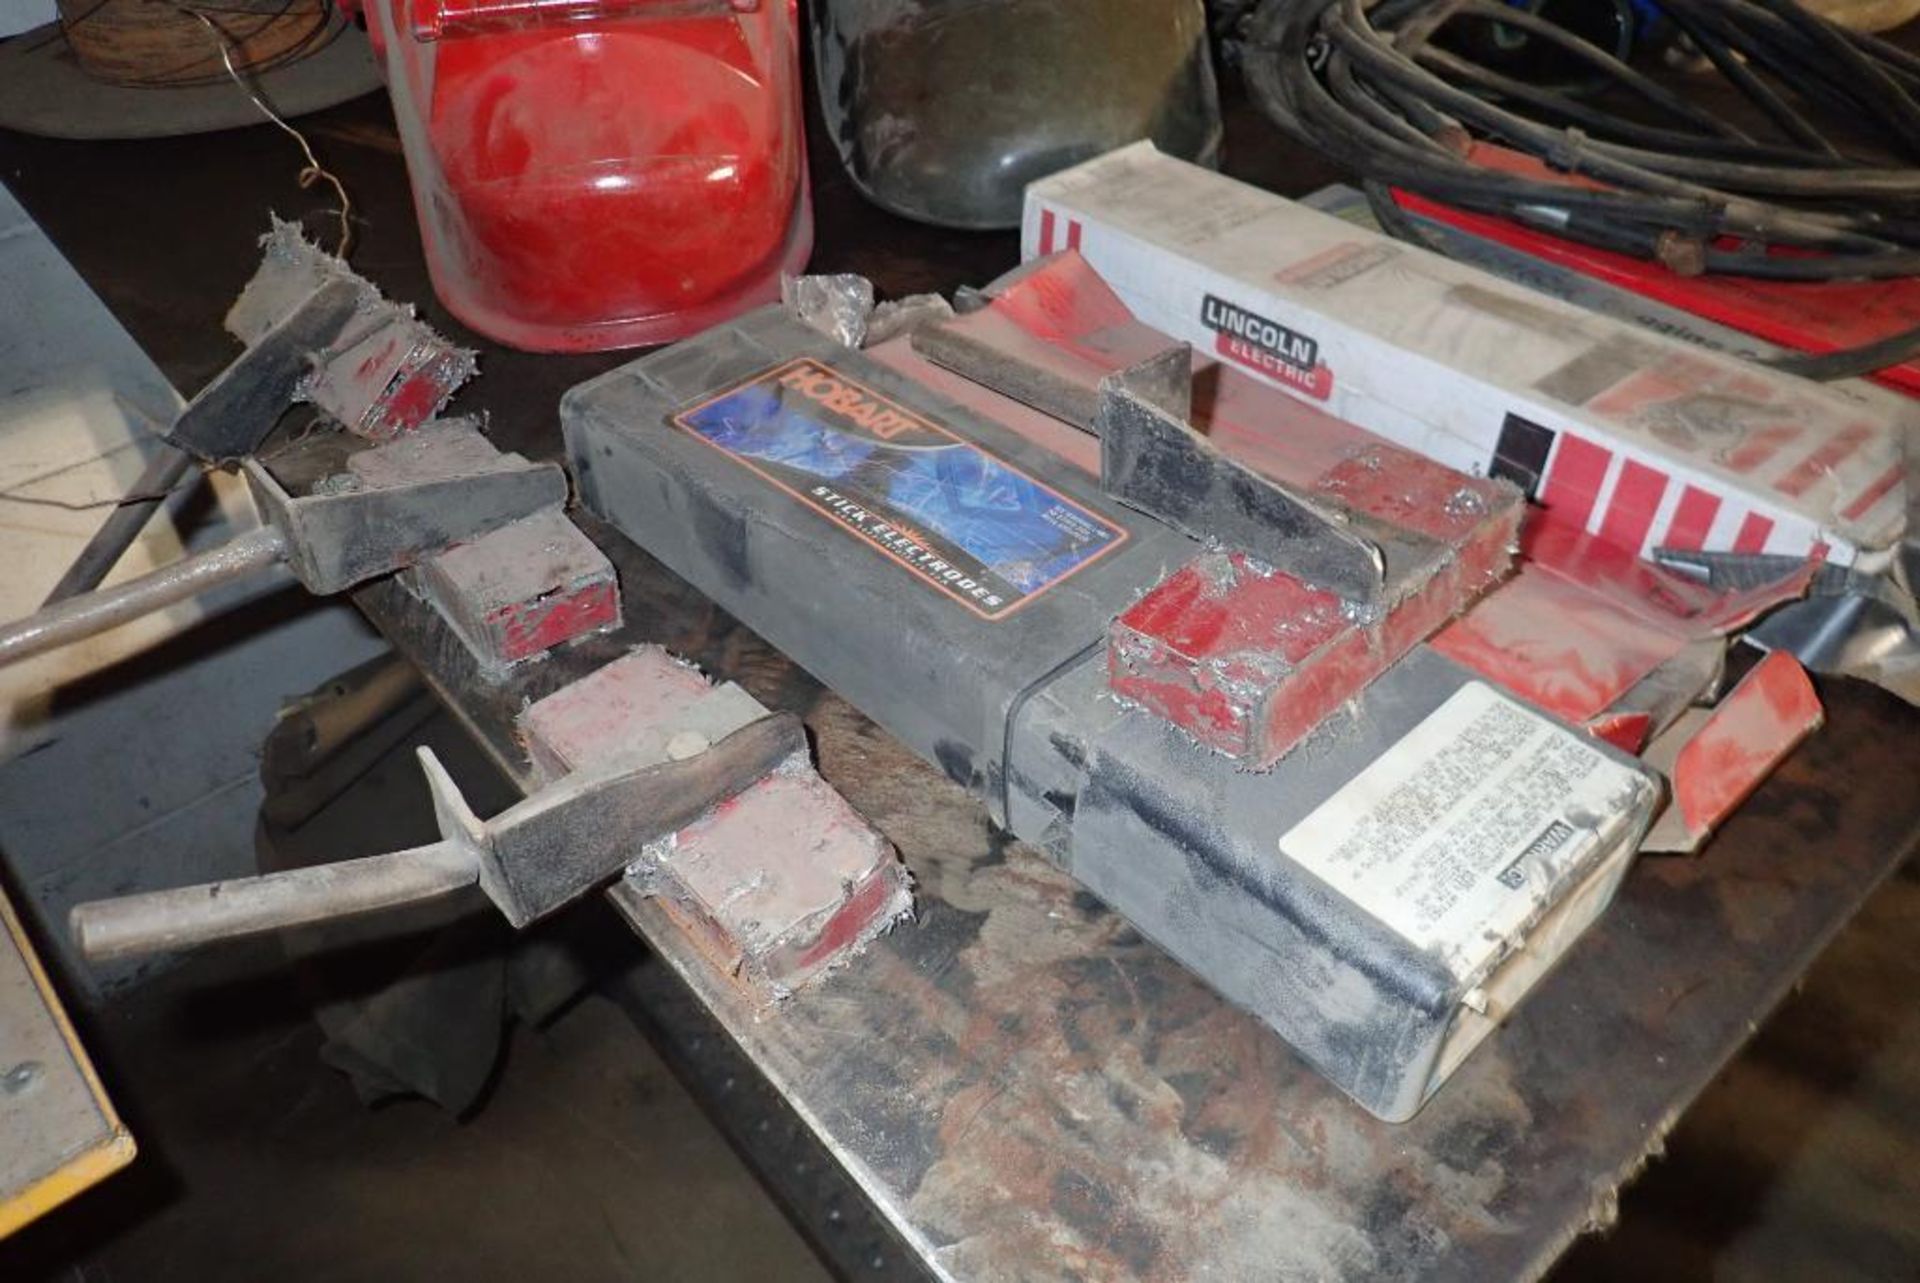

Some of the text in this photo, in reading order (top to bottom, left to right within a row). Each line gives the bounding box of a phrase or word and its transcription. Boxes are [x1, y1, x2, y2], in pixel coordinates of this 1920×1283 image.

[1207, 300, 1311, 364] LINCOLN
[1229, 337, 1317, 389] ELECTRIC
[779, 365, 919, 439] HOBART
[811, 486, 870, 522] STICK
[871, 523, 1004, 607] ELECTRODES
